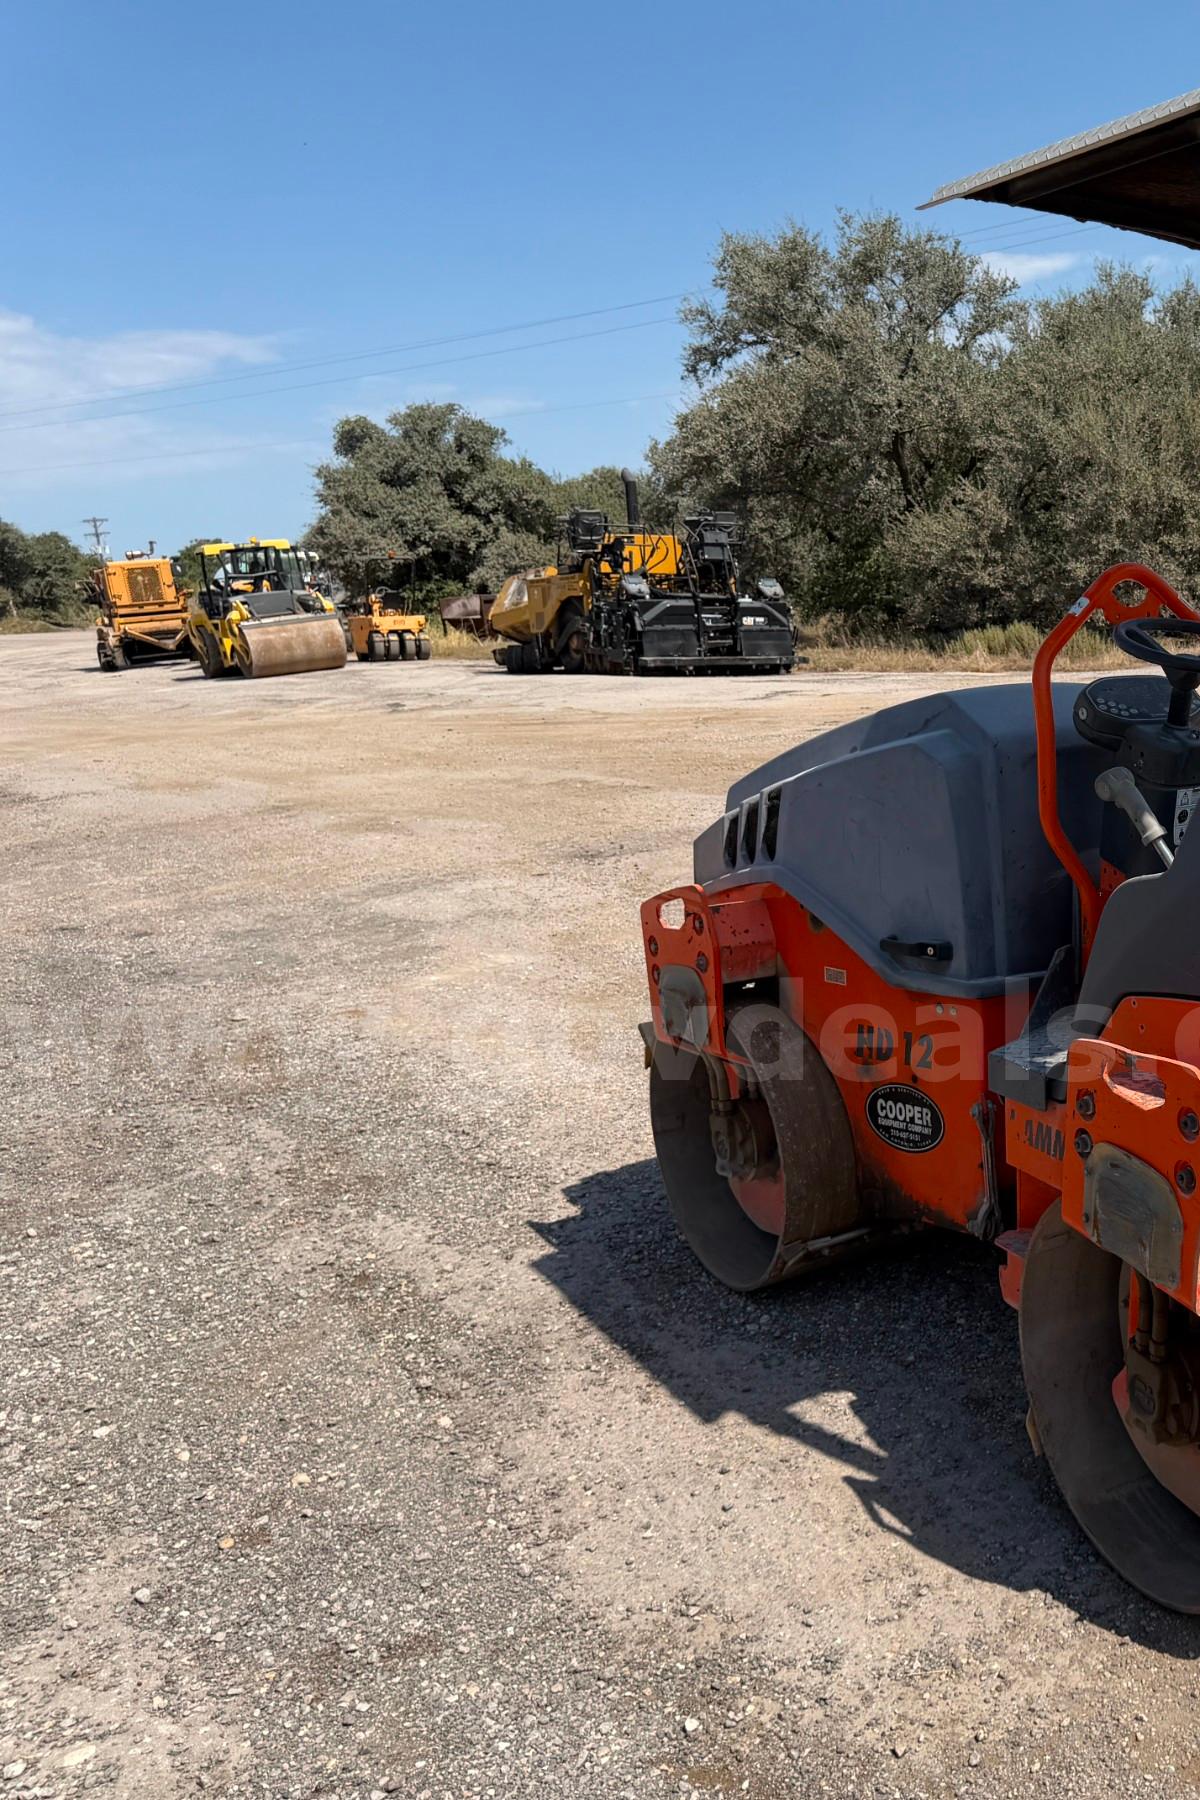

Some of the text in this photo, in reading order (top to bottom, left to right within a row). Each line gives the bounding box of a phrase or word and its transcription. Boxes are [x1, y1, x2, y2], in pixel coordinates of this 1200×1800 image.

[903, 1031, 934, 1069] 12
[877, 1098, 932, 1126] COOPER
[878, 1117, 932, 1136] EQUIPMENT COMPANY
